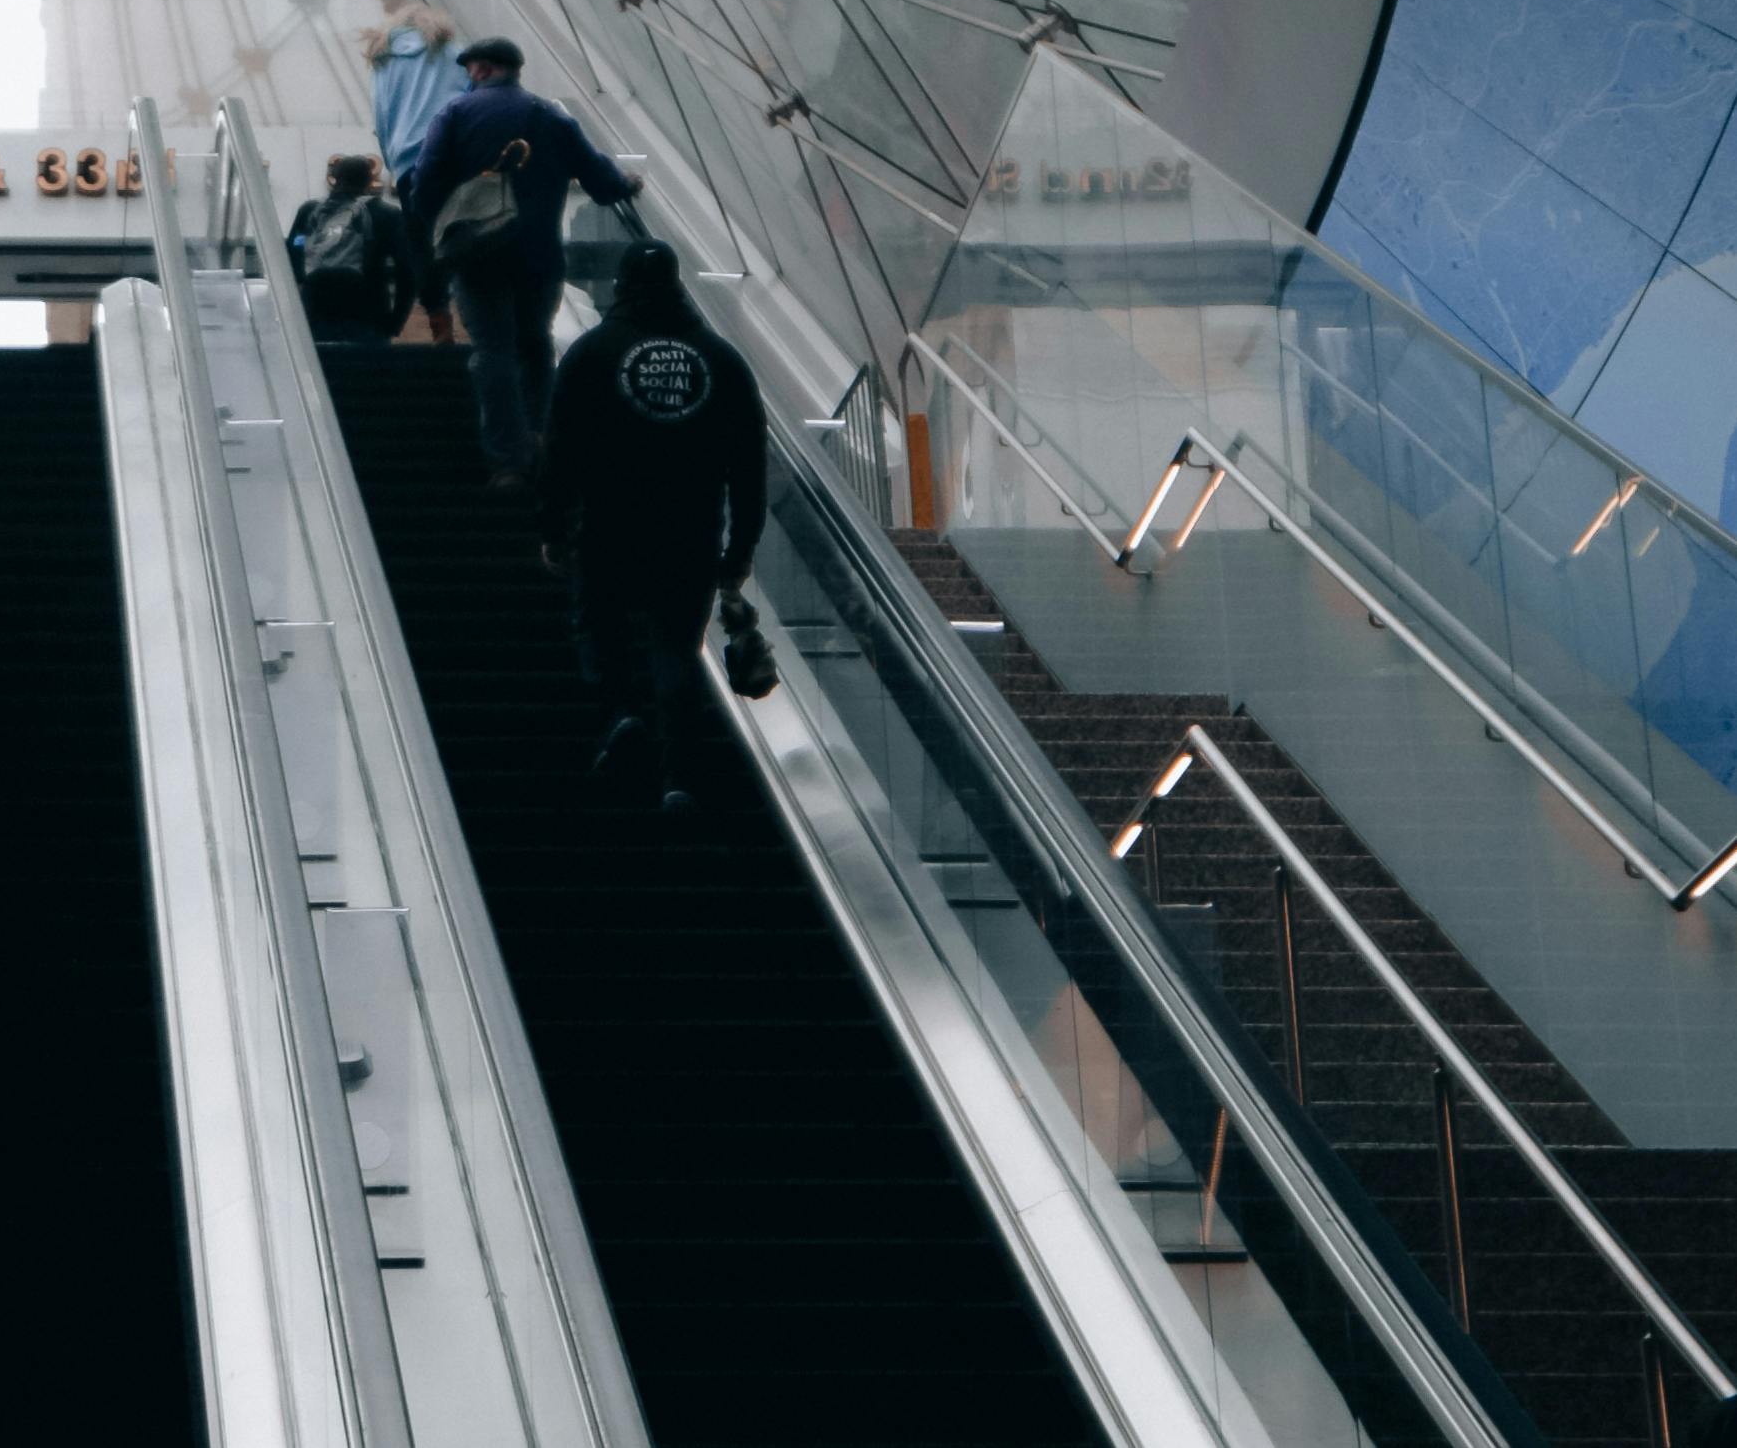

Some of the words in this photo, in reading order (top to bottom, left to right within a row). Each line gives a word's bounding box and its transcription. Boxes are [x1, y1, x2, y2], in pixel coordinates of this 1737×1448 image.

[650, 350, 685, 361] ANTI
[639, 362, 692, 374] SOCIAL
[639, 374, 692, 392] SOCIAL
[647, 390, 685, 406] CLUB
